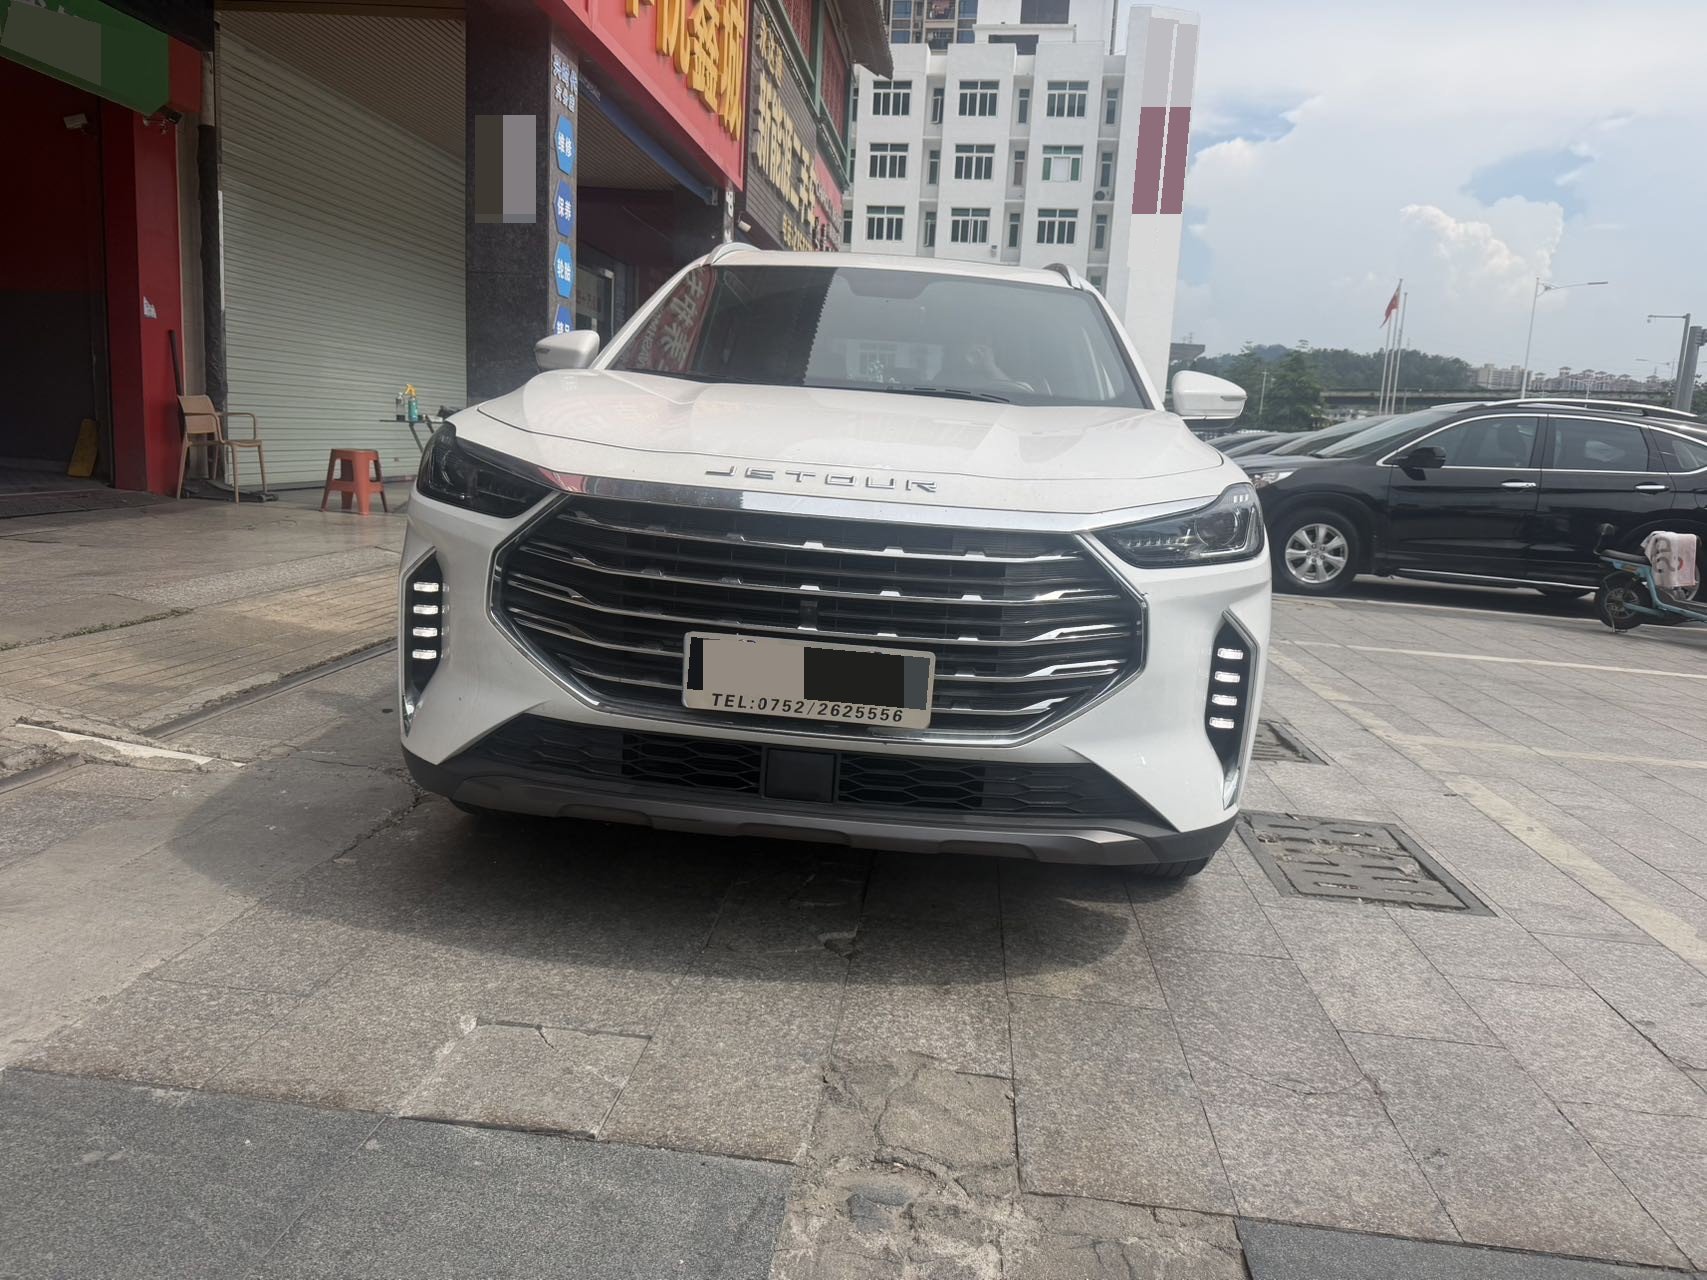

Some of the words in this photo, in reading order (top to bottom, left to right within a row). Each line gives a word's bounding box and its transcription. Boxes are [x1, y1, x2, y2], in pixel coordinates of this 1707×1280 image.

[558, 131, 571, 158] 维修
[557, 195, 571, 221] 保养
[557, 258, 571, 282] 轮胎
[705, 465, 937, 492] JETOUR
[711, 693, 903, 723] TEL:0752/2625556
